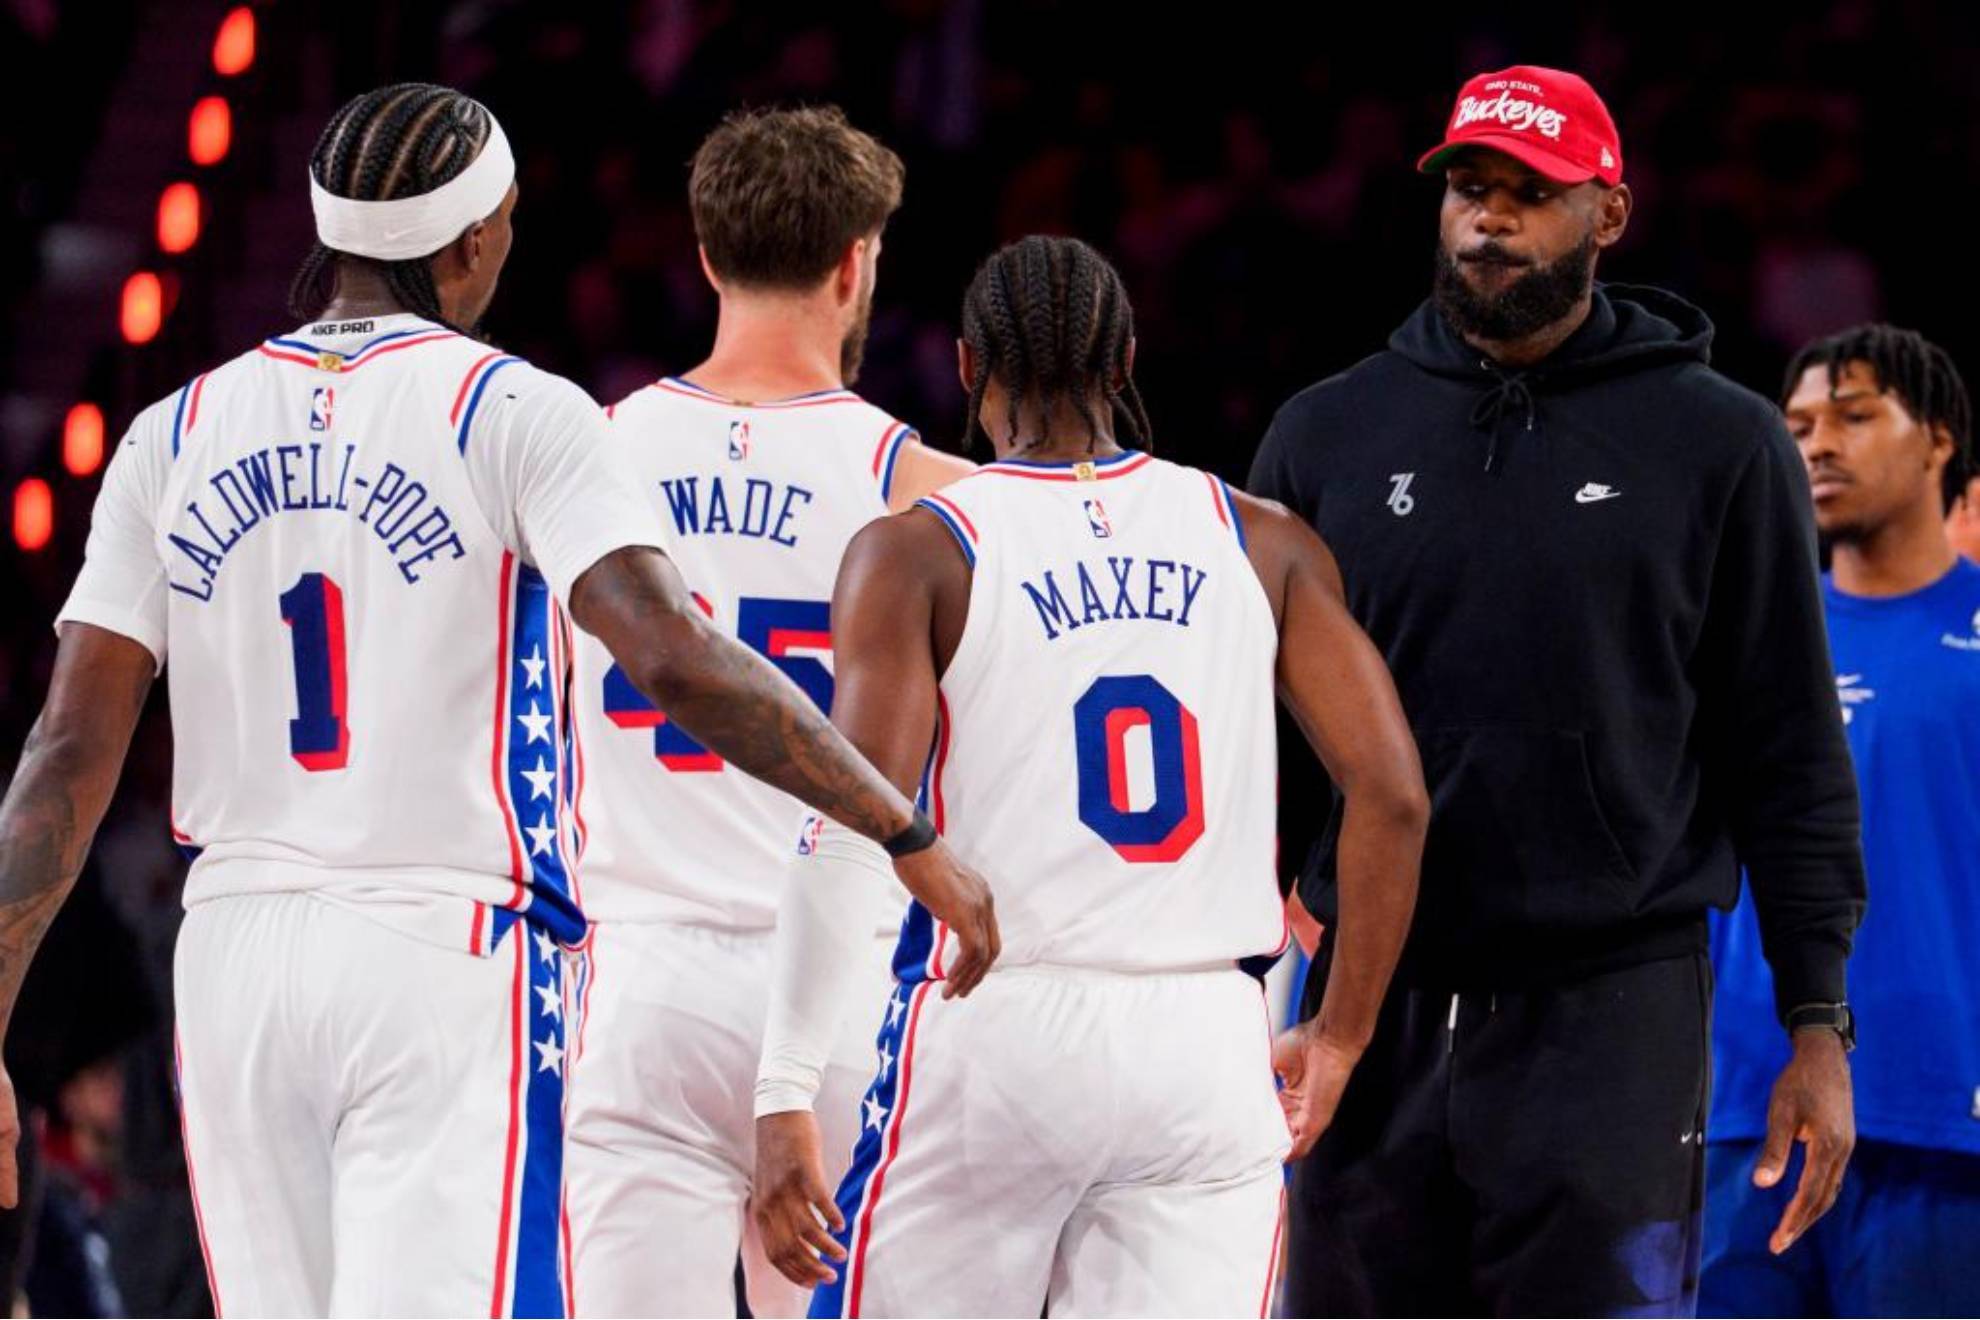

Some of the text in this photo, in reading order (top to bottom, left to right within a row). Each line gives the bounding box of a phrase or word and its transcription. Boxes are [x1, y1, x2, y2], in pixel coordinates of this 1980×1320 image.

[1453, 89, 1567, 138] Buckeyes
[340, 320, 374, 335] PRO
[660, 476, 812, 547] WADE
[1021, 557, 1207, 641] MAXEY
[279, 572, 350, 772] 1
[1074, 674, 1205, 863] 0
